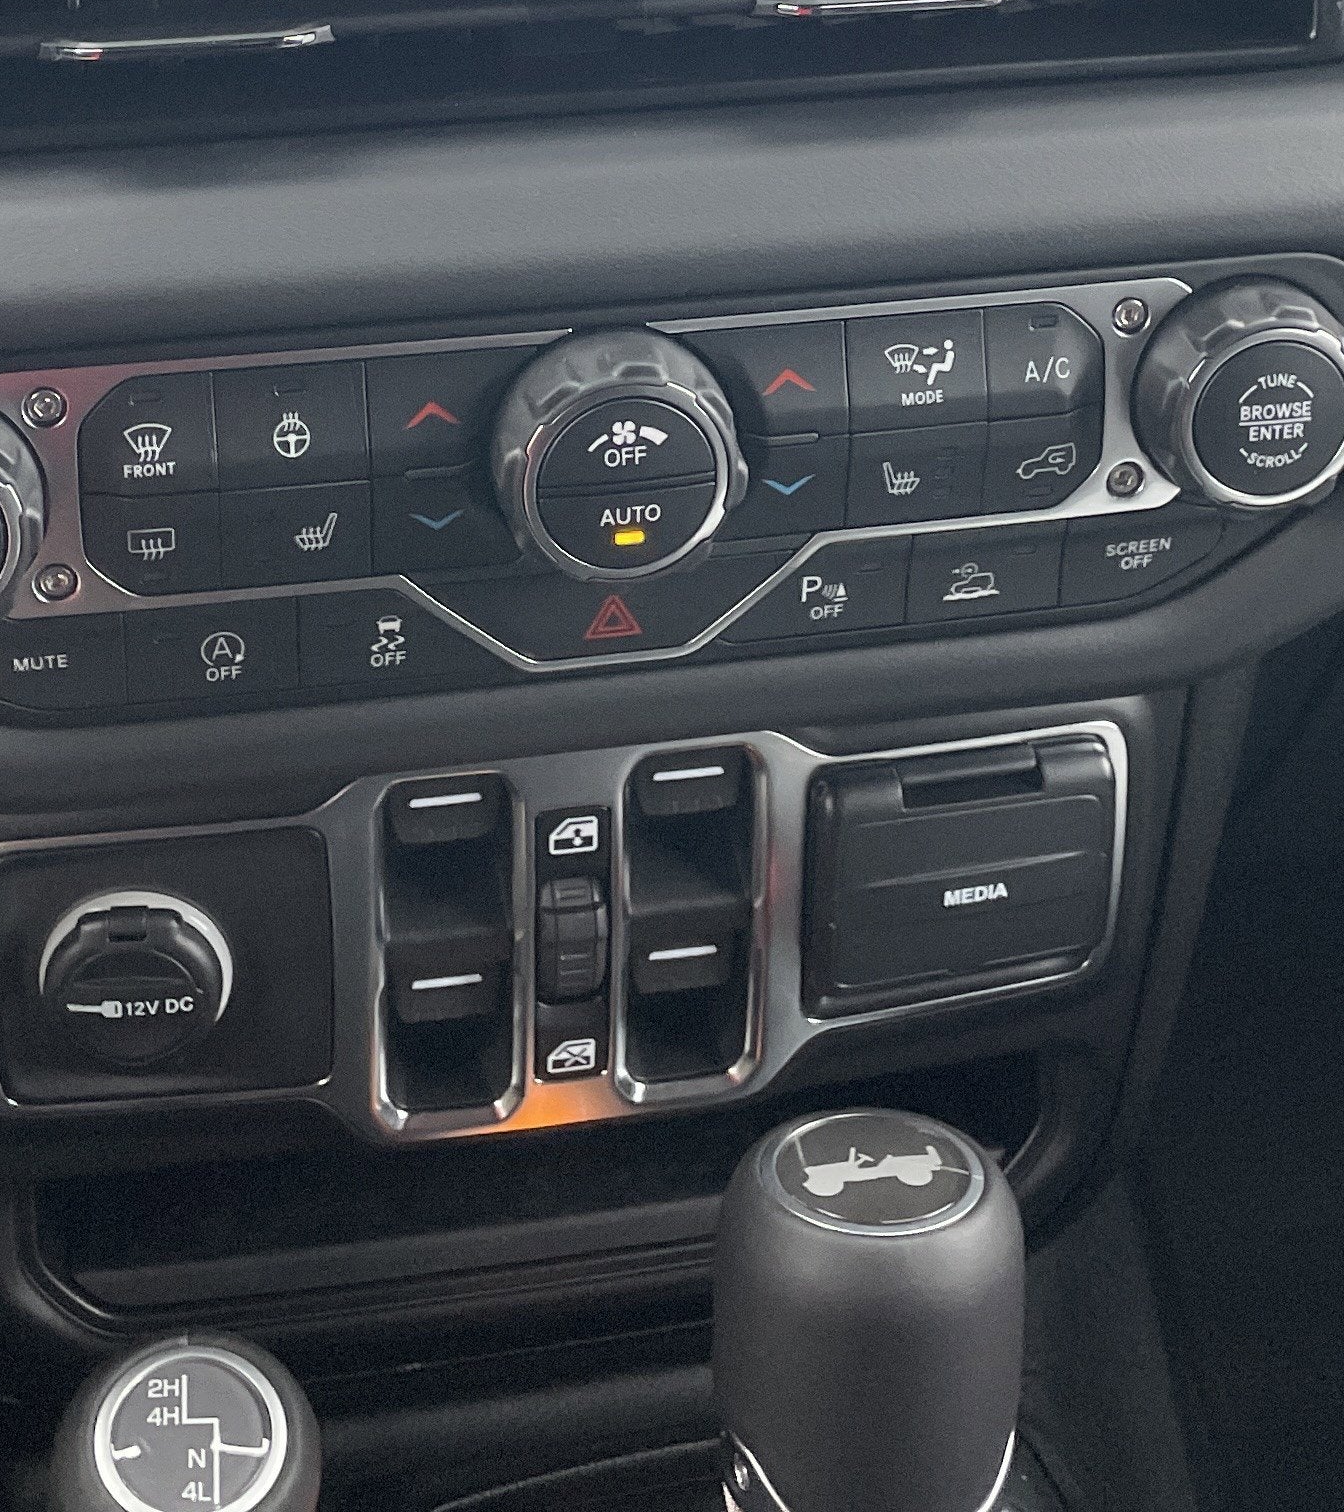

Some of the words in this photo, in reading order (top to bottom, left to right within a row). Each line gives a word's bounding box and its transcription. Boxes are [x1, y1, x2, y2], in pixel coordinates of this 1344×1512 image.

[1024, 357, 1071, 383] A/C
[1258, 372, 1298, 390] TUNE
[901, 390, 944, 406] MODE
[1240, 401, 1312, 420] BROWSE
[1249, 424, 1304, 441] ENTER
[604, 445, 647, 467] OFF
[1246, 449, 1302, 468] SCROLL
[123, 461, 176, 478] FRONT
[600, 504, 662, 526] AUTO
[1106, 538, 1172, 557] SCREEN
[1121, 554, 1153, 570] OFF
[811, 605, 844, 619] OFF
[13, 653, 69, 672] MUTE
[370, 651, 406, 667] OFF
[206, 666, 242, 681] OFF
[944, 883, 1008, 907] MEDIA
[126, 1000, 159, 1016] 12V
[164, 996, 194, 1014] DC
[147, 1378, 180, 1398] 2H
[146, 1405, 179, 1427] 4H
[188, 1448, 206, 1469] N
[181, 1481, 211, 1502] 4L
